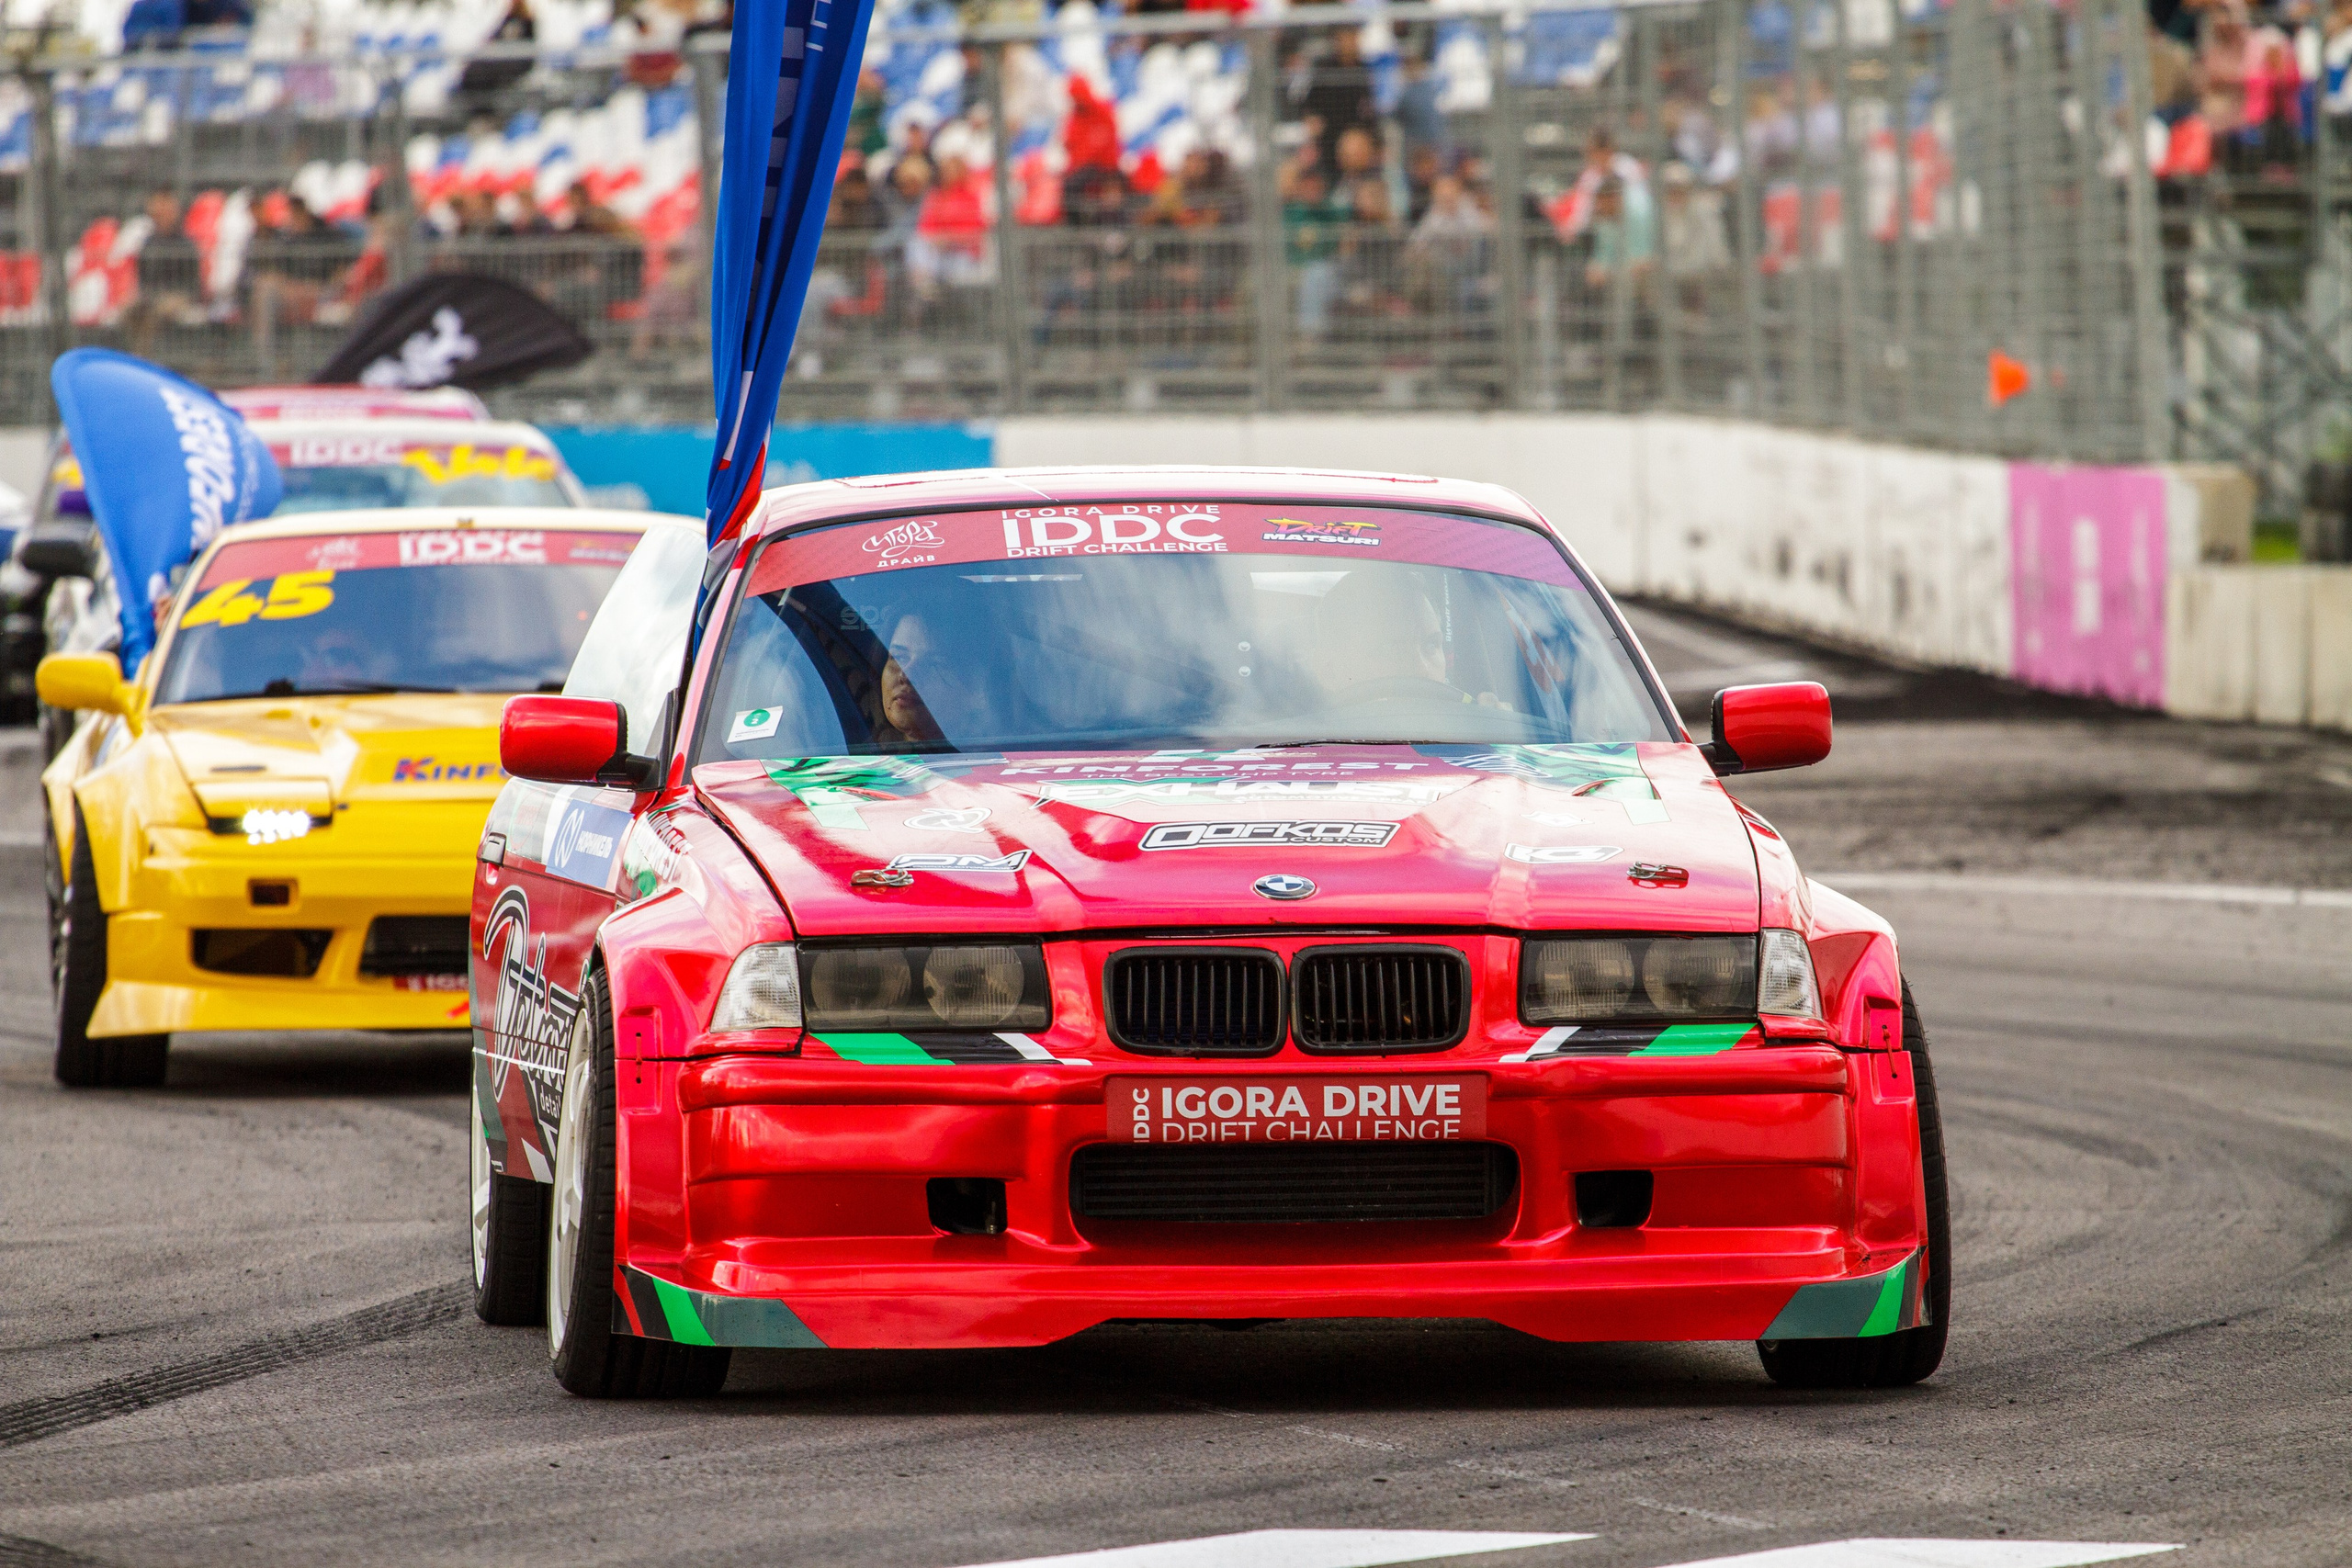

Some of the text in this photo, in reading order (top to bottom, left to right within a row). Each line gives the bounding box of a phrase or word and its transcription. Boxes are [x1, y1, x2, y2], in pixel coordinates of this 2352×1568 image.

[1001, 504, 1221, 519] IGORA DRIVE
[1002, 513, 1225, 548] IDDC
[1262, 533, 1380, 546] MATSURI
[1007, 542, 1228, 558] DRIFT CHALLENGE
[876, 555, 935, 568] ДРАЙВ
[181, 570, 335, 629] 45
[1000, 761, 1429, 775] KINFOREST
[1049, 781, 1450, 802] EXHAUST
[1162, 1084, 1462, 1119] IGORA DRIVE
[1162, 1119, 1460, 1143] DRIFT CHALLENGE
